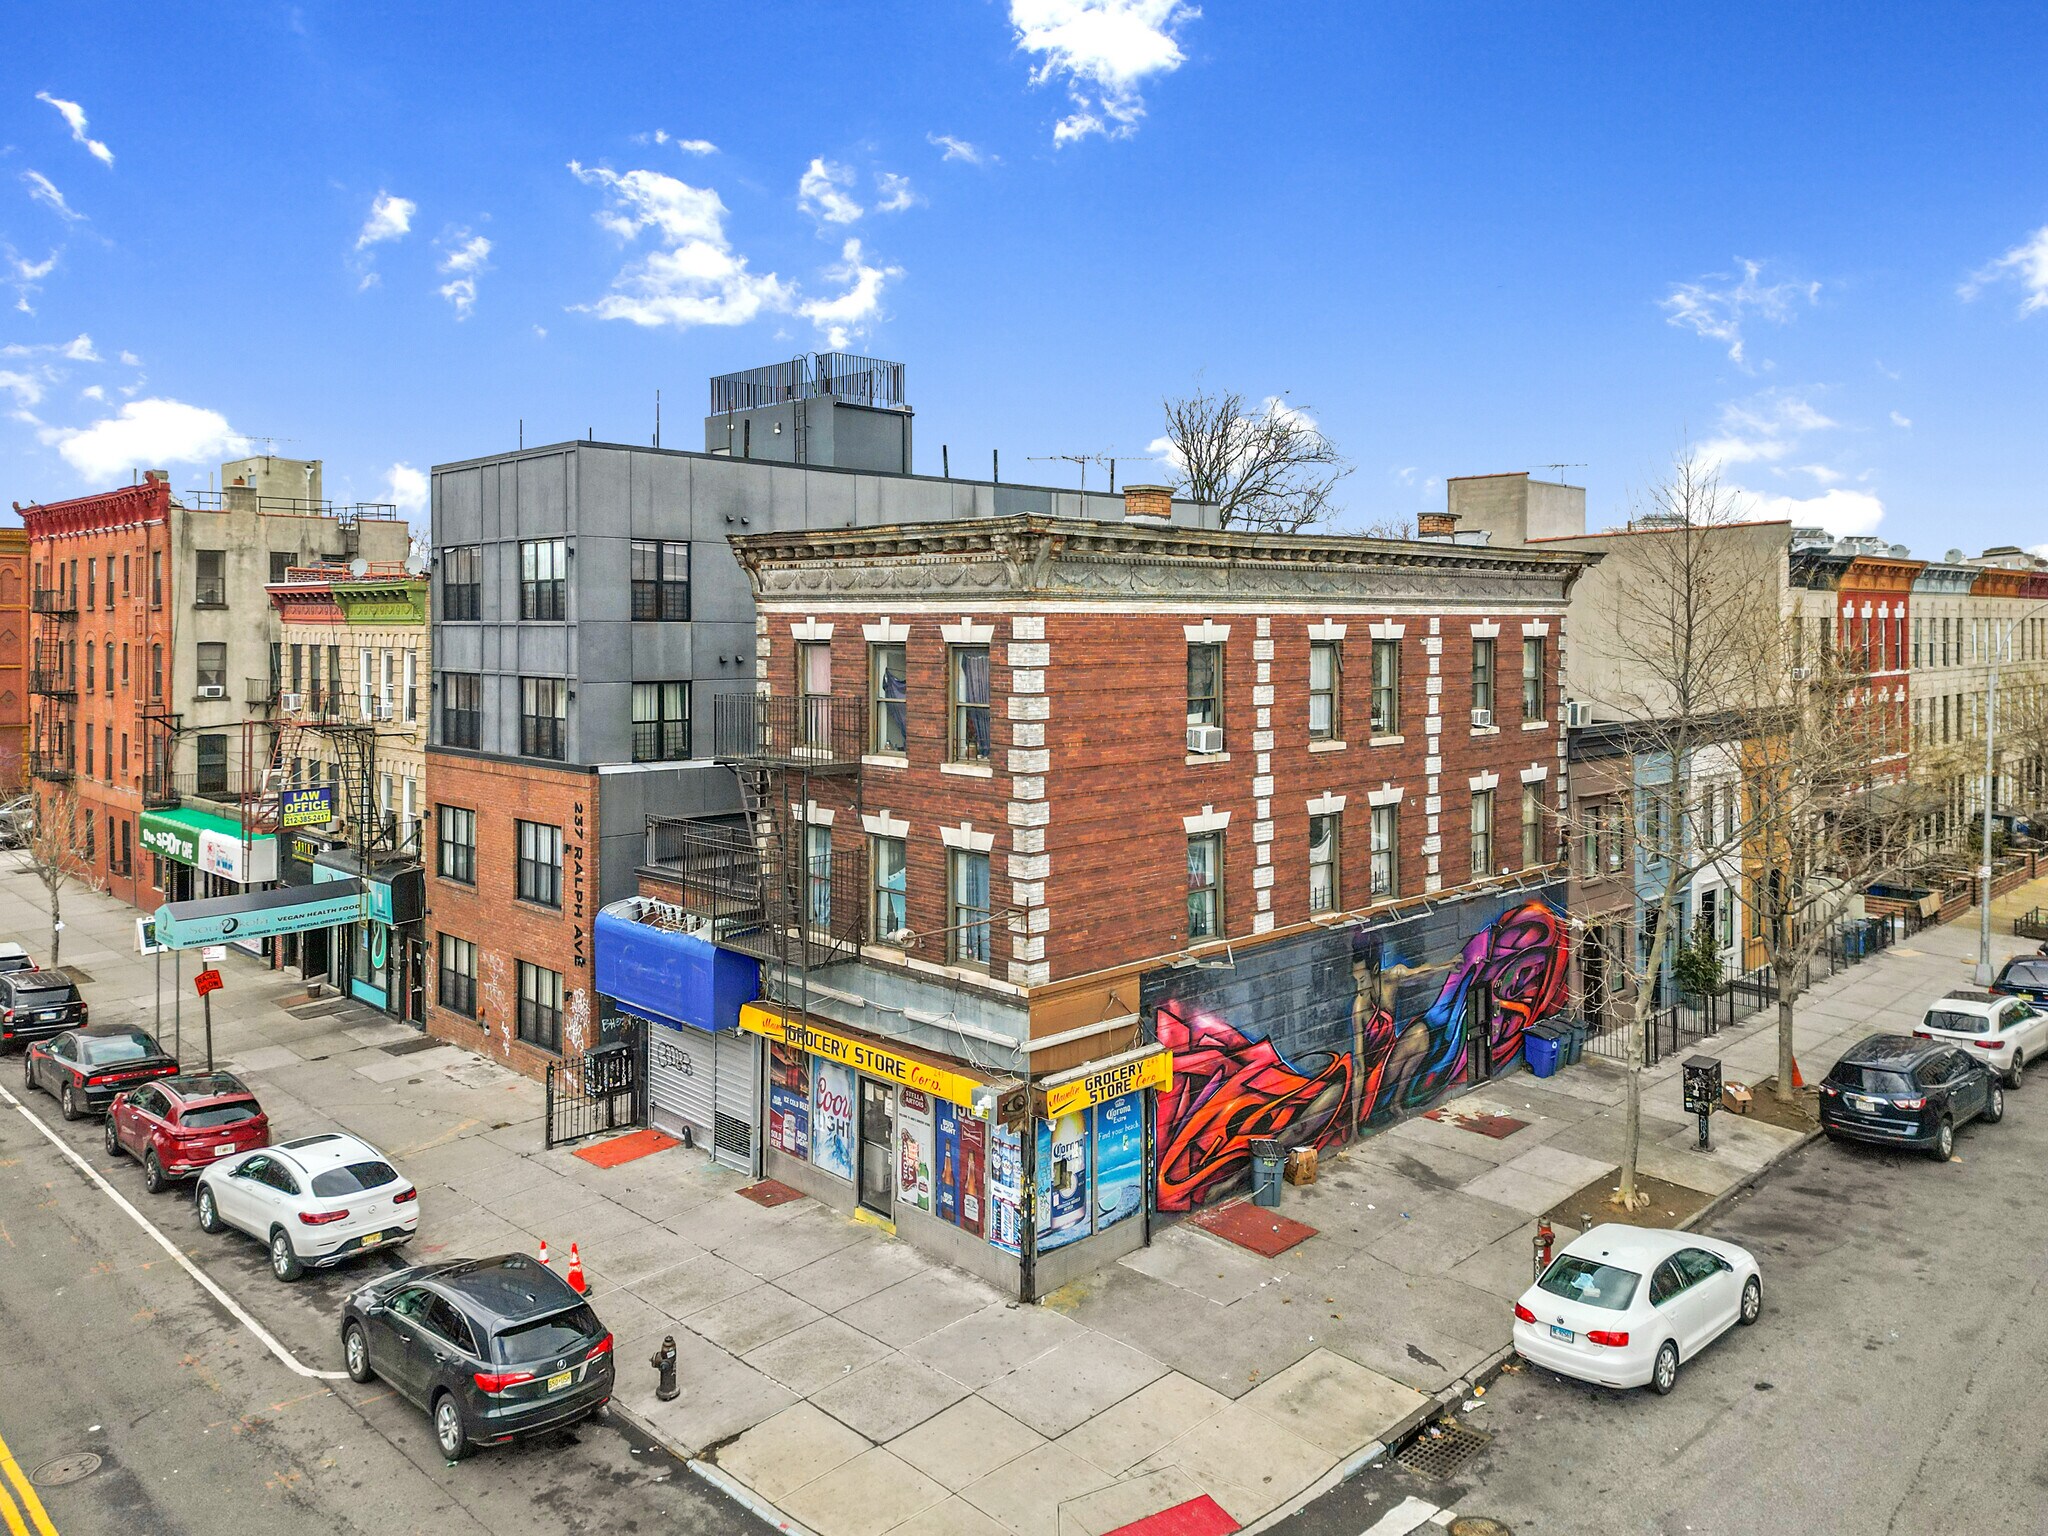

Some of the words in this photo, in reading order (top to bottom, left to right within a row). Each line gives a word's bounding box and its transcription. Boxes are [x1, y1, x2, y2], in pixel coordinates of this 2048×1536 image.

[293, 791, 320, 802] LAW
[285, 800, 329, 813] OFFICE
[574, 802, 584, 840] 237
[574, 846, 584, 918] RALPH
[277, 914, 305, 922] VEGAN
[307, 908, 337, 917] HEALTH
[183, 937, 218, 946] BREAKFAST
[296, 921, 320, 929] SPECIAL
[574, 924, 585, 968] AVE
[788, 1025, 849, 1059] GROCERY
[855, 1047, 906, 1079] STORE
[911, 1066, 941, 1091] Corp.
[1085, 1062, 1144, 1091] GROCERY
[905, 1090, 924, 1102] STELLA
[1090, 1078, 1132, 1104] STORE
[790, 1098, 799, 1108] COLD
[905, 1098, 924, 1108] ARTOIS
[1106, 1105, 1131, 1120] Corona
[940, 1123, 956, 1136] LIGHT
[942, 1118, 954, 1128] BUD
[770, 1129, 782, 1140] SOLD
[1098, 1130, 1111, 1141] Find
[770, 1139, 782, 1149] HERE
